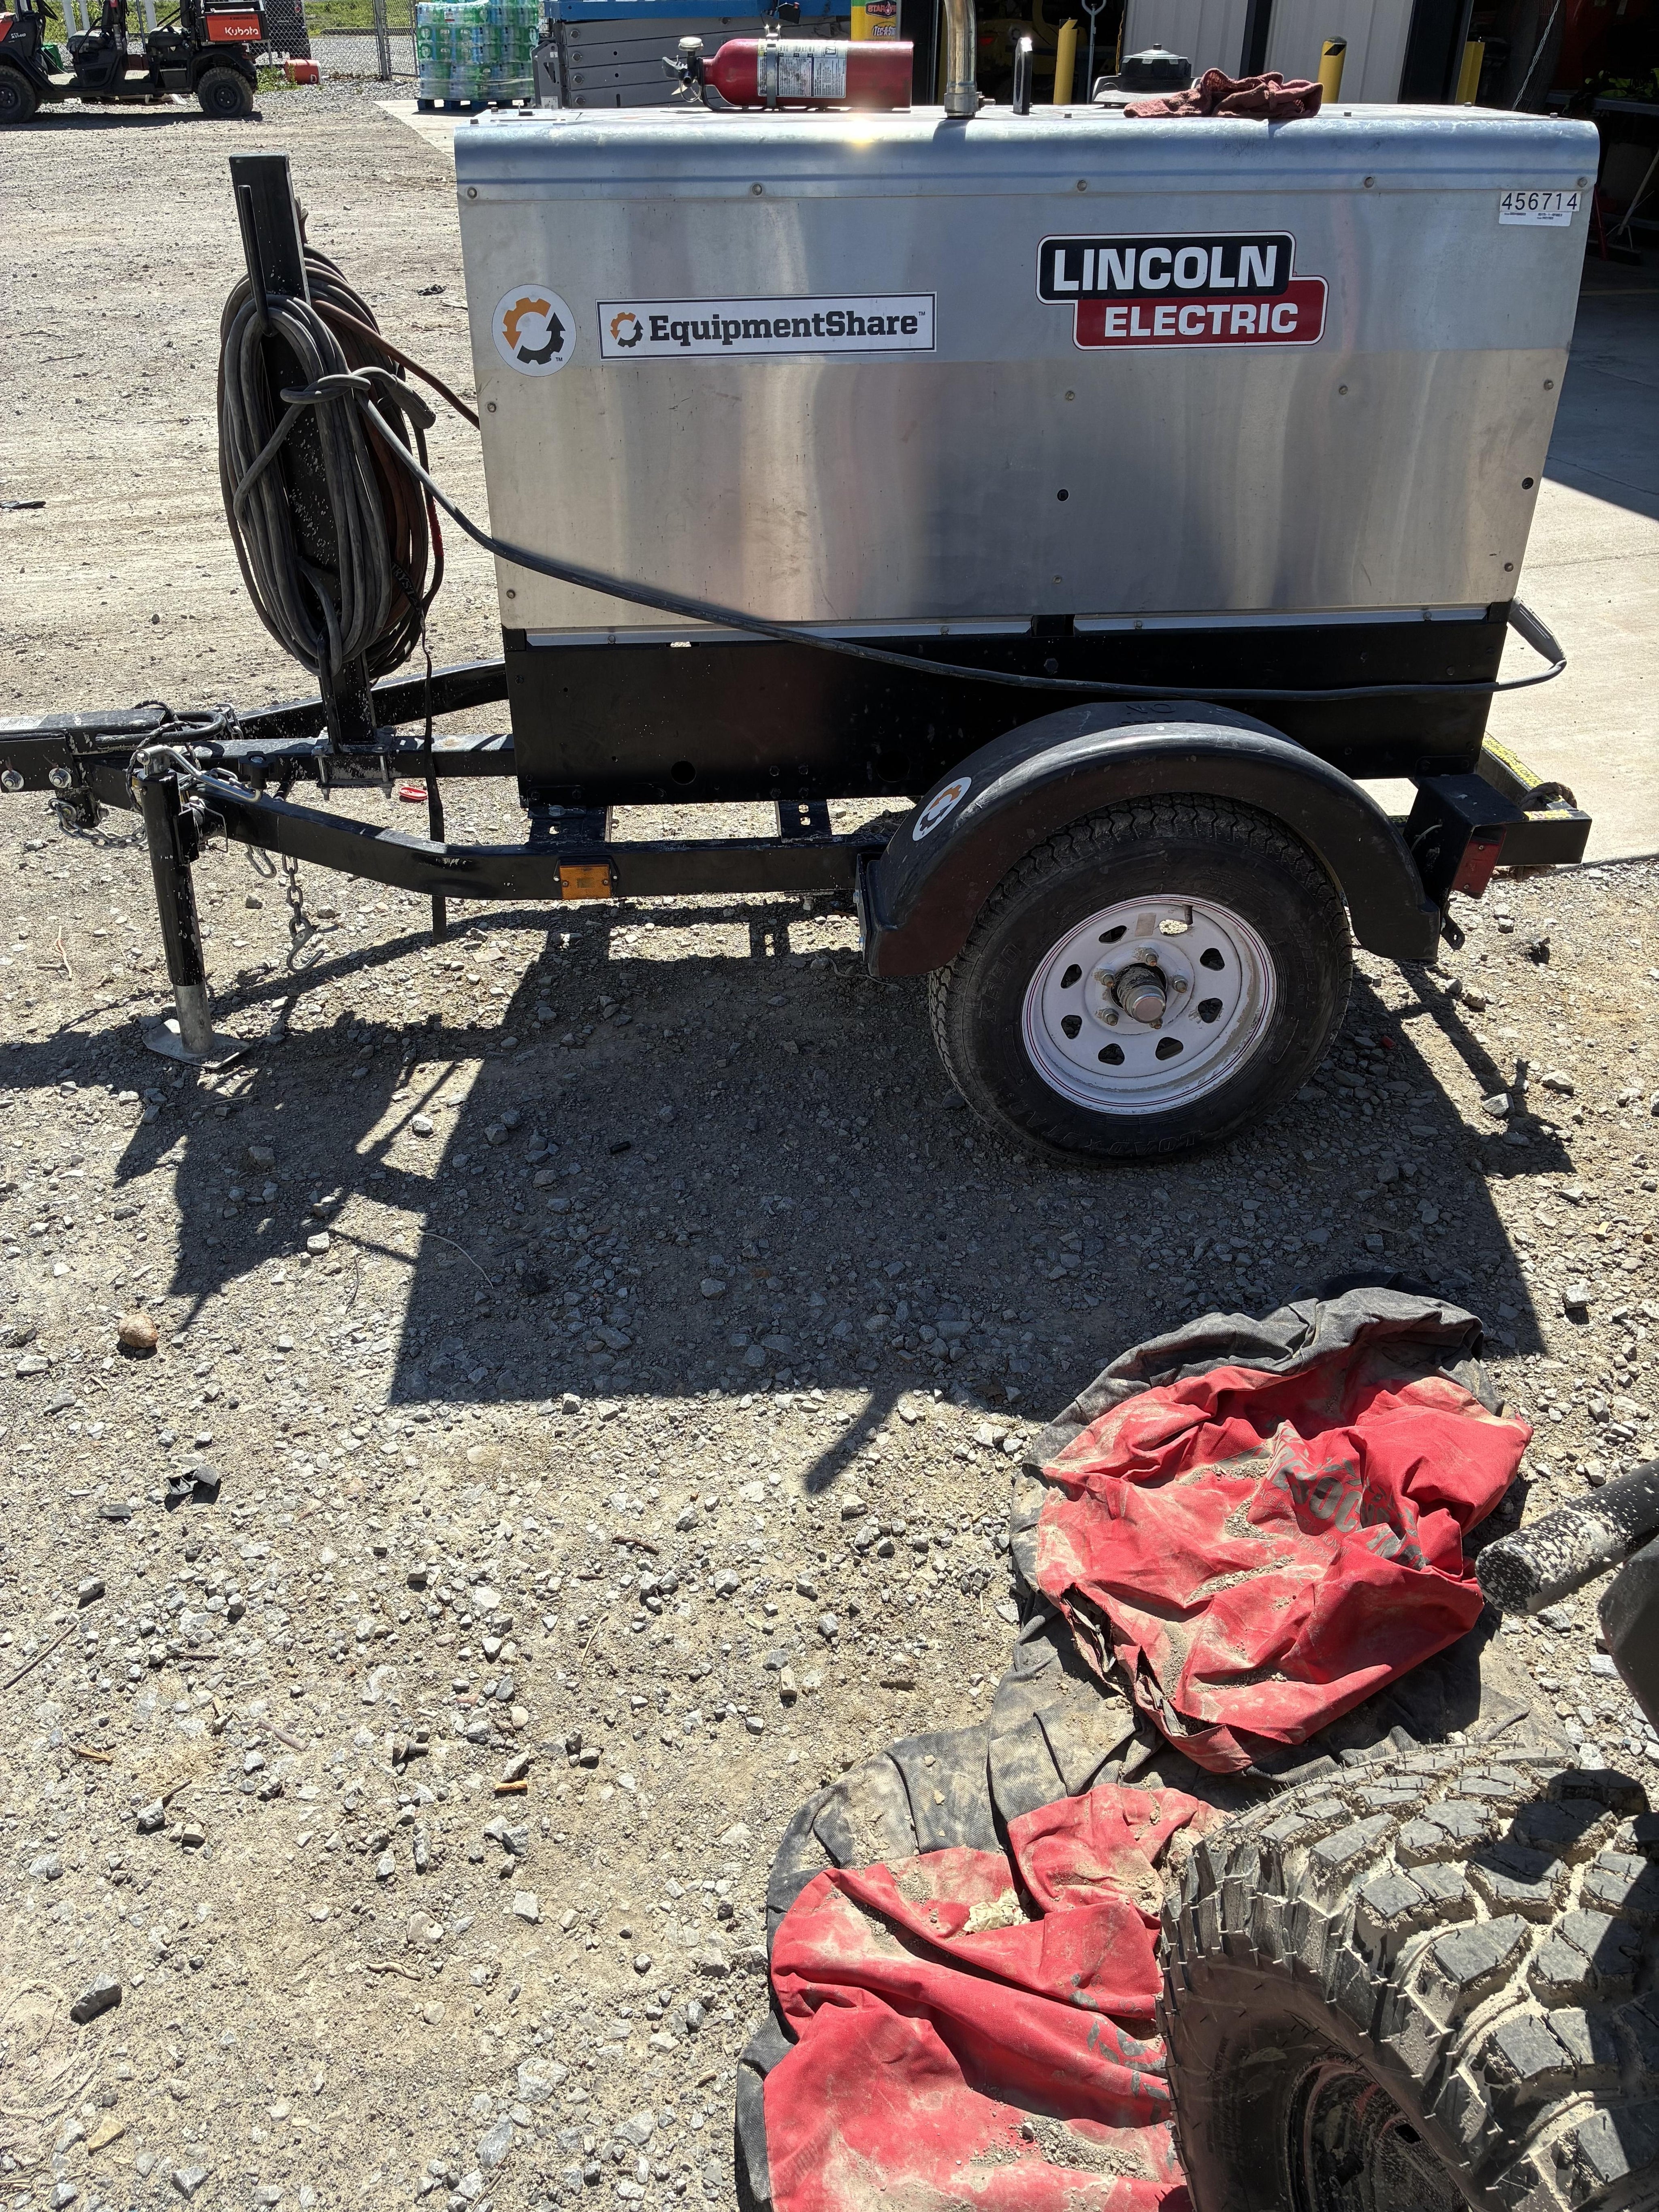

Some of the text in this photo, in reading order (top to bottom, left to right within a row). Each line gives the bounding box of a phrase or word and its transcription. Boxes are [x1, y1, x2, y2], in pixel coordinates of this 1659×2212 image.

[224, 26, 259, 36] Kubota
[1501, 192, 1577, 210] 456714
[1053, 245, 1277, 291] LINCOLN
[648, 311, 918, 346] EquipmentShare
[1105, 303, 1298, 337] ELECTRIC
[1516, 766, 1532, 779] NOT
